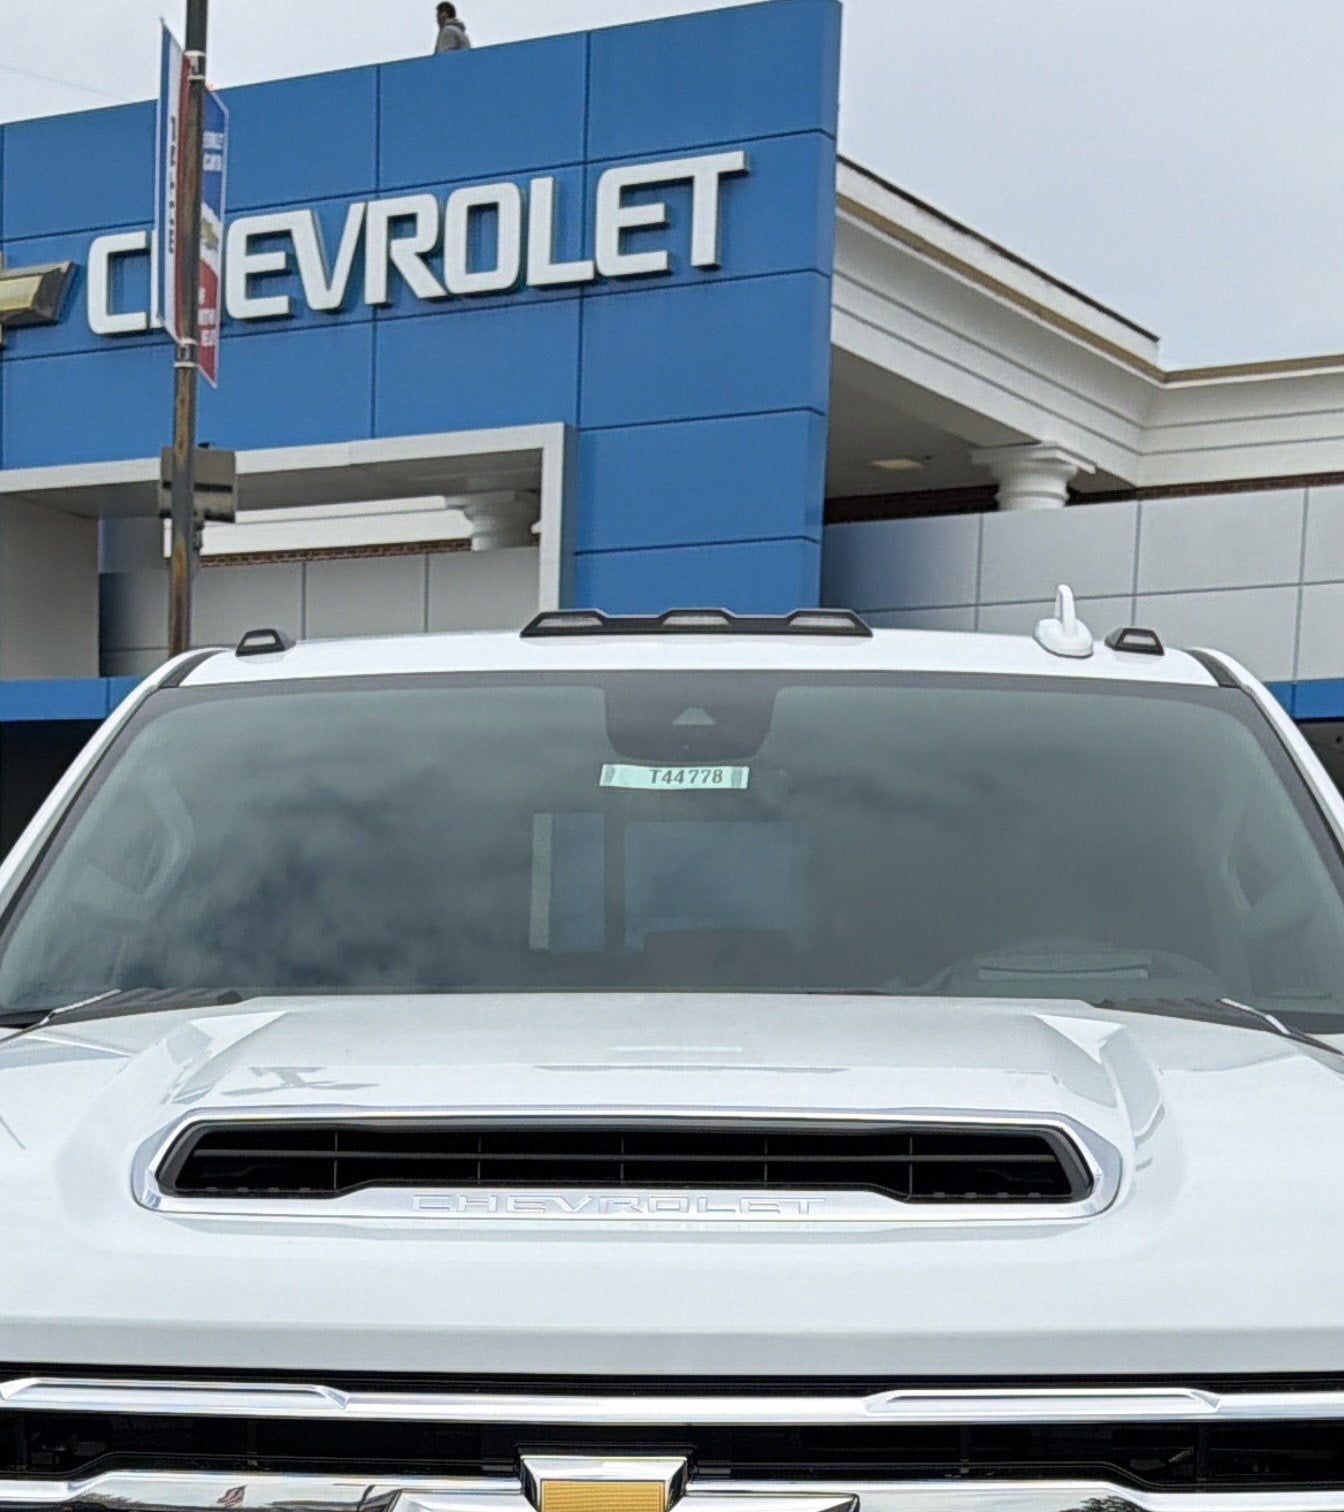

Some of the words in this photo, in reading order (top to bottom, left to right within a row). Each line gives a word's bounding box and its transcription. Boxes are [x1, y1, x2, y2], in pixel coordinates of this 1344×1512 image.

[88, 150, 747, 335] CEVROLET
[649, 769, 724, 784] T44778
[412, 1194, 826, 1215] CHEVROLET
